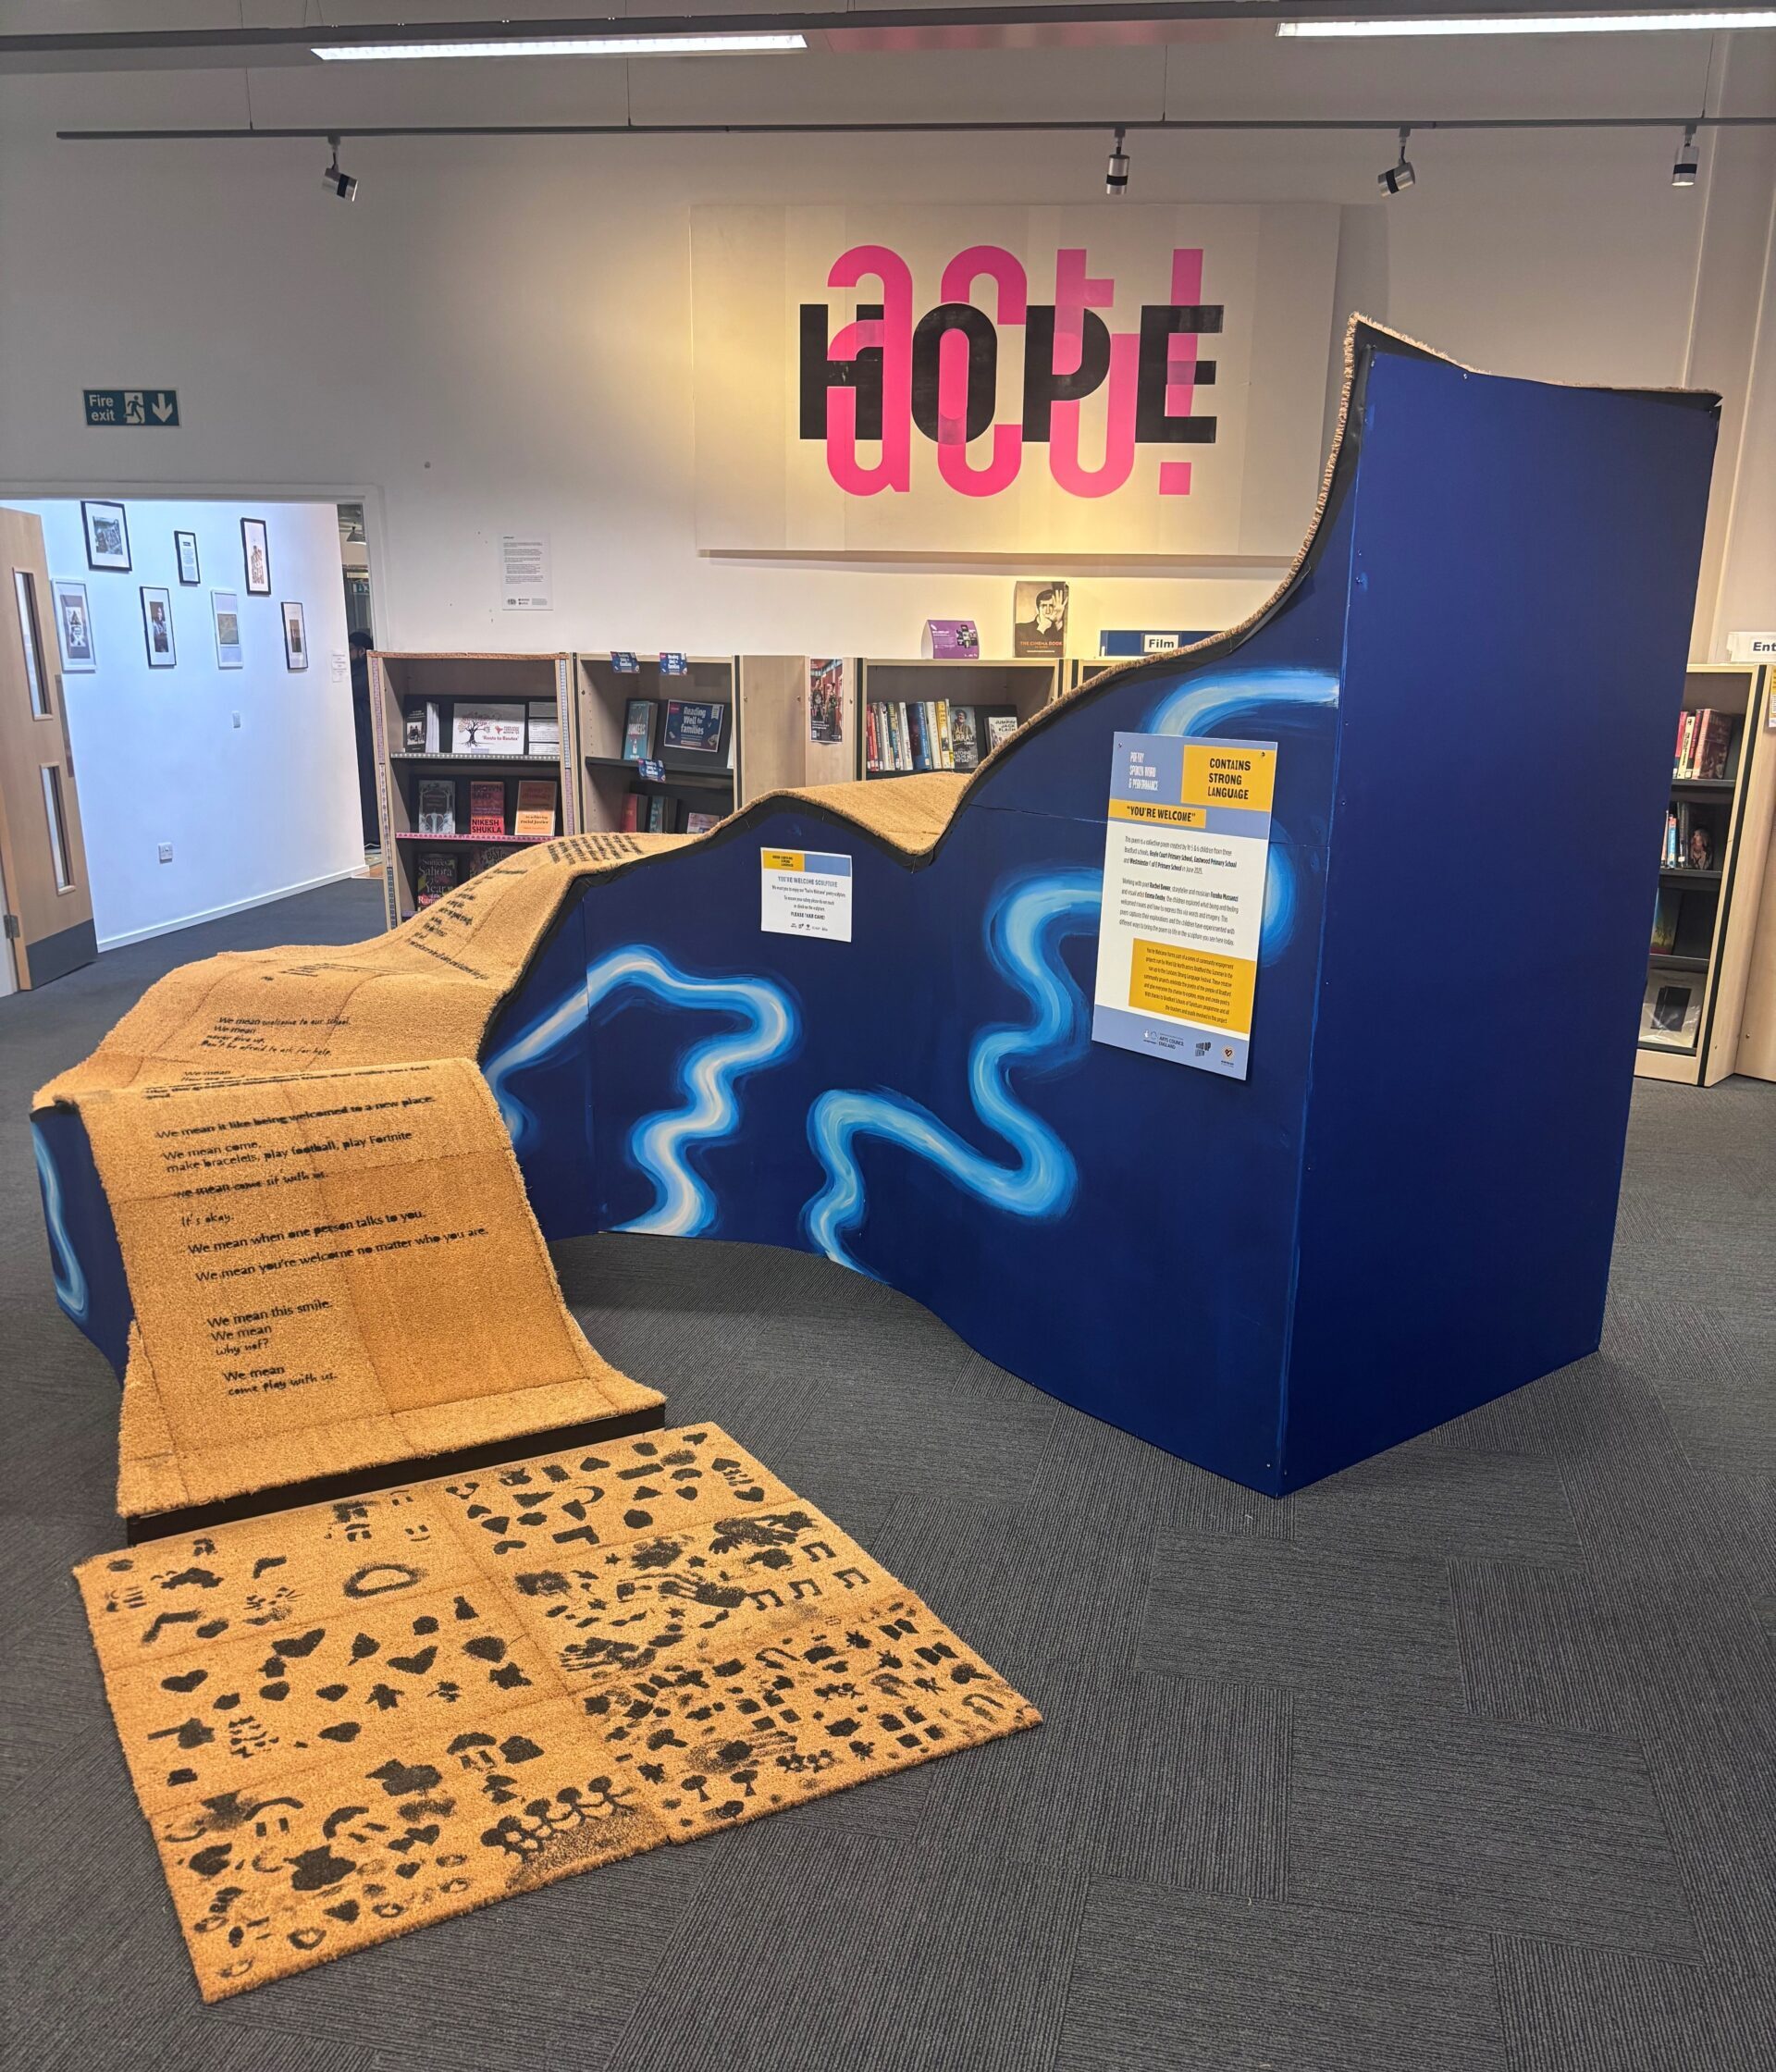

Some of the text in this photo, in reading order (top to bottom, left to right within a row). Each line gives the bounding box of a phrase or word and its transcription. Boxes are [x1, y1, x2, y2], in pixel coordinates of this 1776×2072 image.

[799, 303, 1225, 444] HOPE
[89, 394, 113, 407] Fire
[91, 409, 115, 421] exit
[1149, 639, 1175, 648] Film
[684, 707, 706, 718] Reading
[684, 716, 697, 724] Well
[681, 725, 704, 735] families
[1210, 758, 1251, 771] CONTAINS
[1209, 773, 1242, 785] STRONG
[1208, 786, 1249, 799] LANGUAGE
[155, 1130, 179, 1139] We
[181, 1126, 215, 1136] mean
[217, 1123, 226, 1131] it
[253, 1116, 289, 1126] being
[289, 1106, 348, 1122] welcomed
[374, 1101, 399, 1109] new
[163, 1152, 185, 1161] We
[187, 1146, 222, 1157] mean
[166, 1161, 200, 1173] make
[264, 1149, 288, 1163] play
[342, 1138, 366, 1151] play
[369, 1131, 413, 1144] Fortnite
[195, 1184, 230, 1195] mean
[232, 1180, 262, 1190] come
[266, 1176, 279, 1186] sit
[282, 1171, 310, 1183] with
[205, 1212, 234, 1227] okay.
[187, 1210, 426, 1254] We mean when one person talks to you.
[195, 1227, 488, 1282] We mean you're welcome no matter who you are.
[207, 1299, 333, 1328] We mean this smile.
[211, 1325, 272, 1341] We mean
[216, 1338, 269, 1356] why not?
[222, 1366, 285, 1382] We mean
[228, 1386, 258, 1396] come
[263, 1380, 287, 1392] play
[290, 1373, 317, 1387] with
